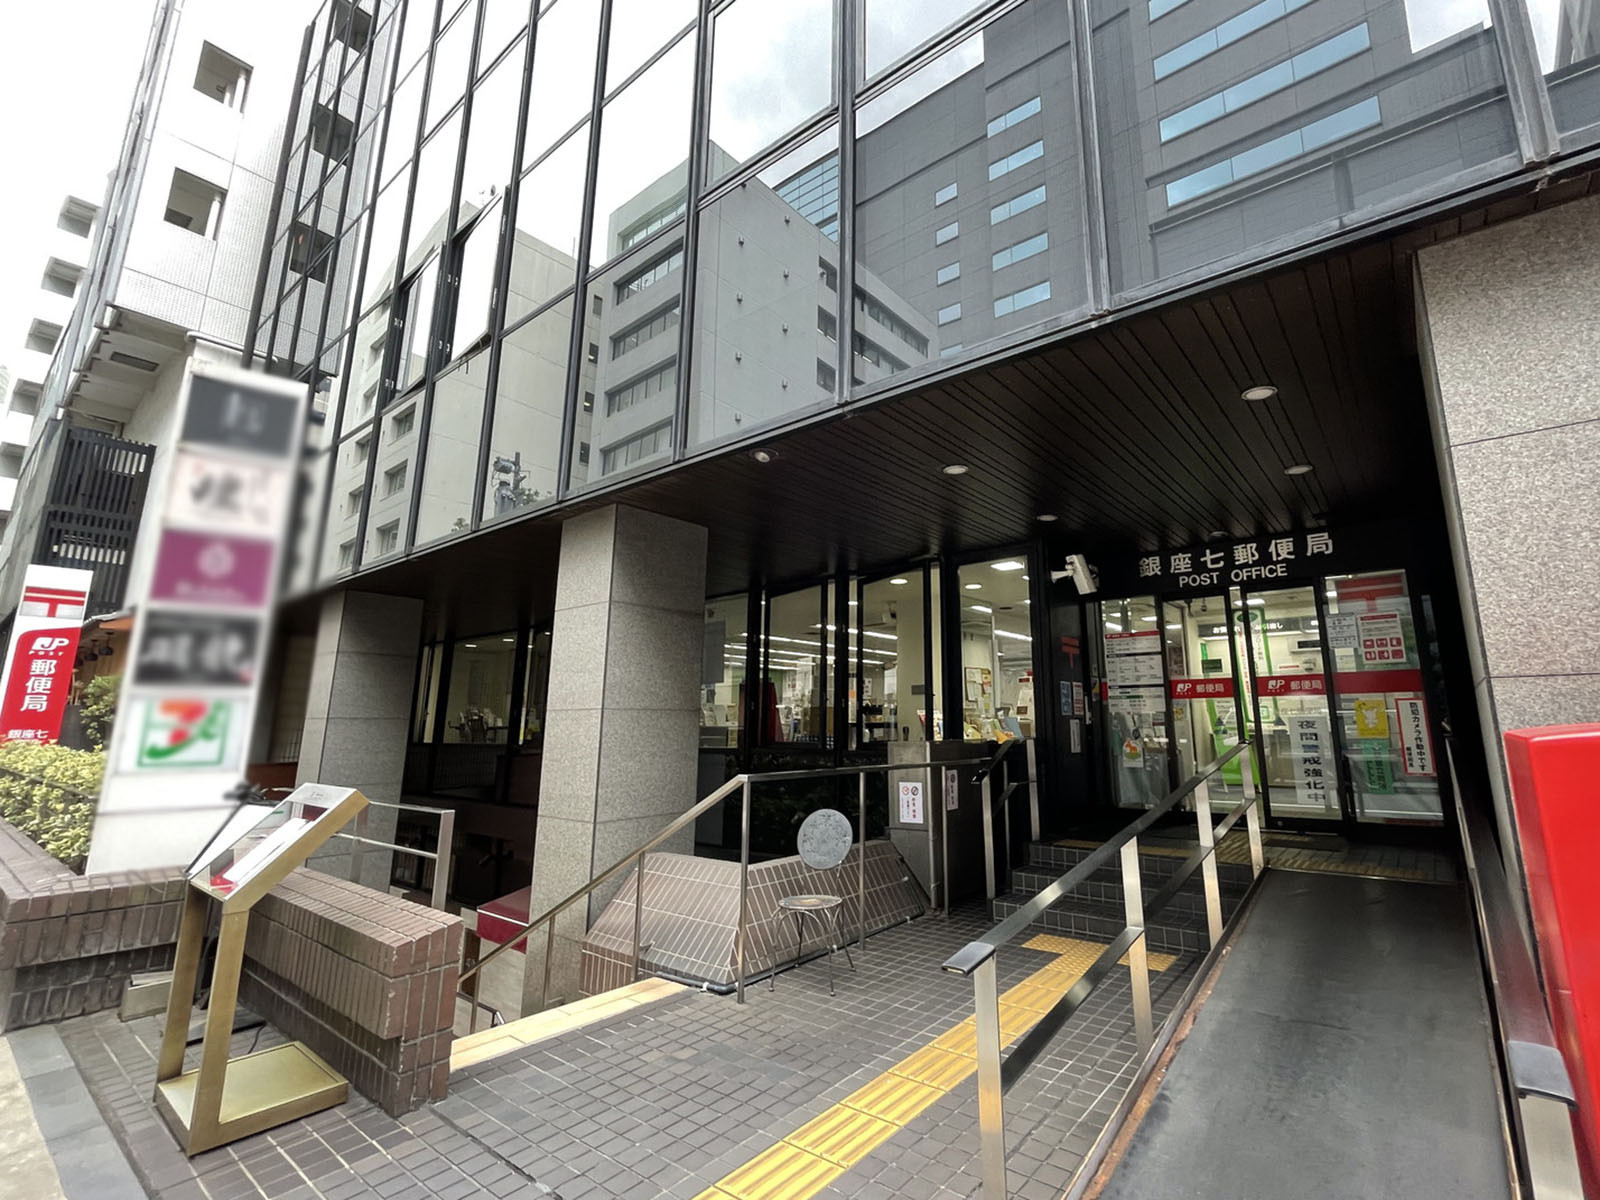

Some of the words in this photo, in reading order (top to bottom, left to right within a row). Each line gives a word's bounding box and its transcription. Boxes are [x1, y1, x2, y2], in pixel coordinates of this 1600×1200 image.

[1138, 531, 1334, 578] 銀座七郵便局
[1179, 571, 1220, 588] POST
[1230, 563, 1289, 582] OFFICE
[31, 636, 70, 651] JP
[20, 659, 58, 713] 郵便局
[1196, 683, 1225, 693] 郵便局
[1290, 679, 1323, 690] 郵便局
